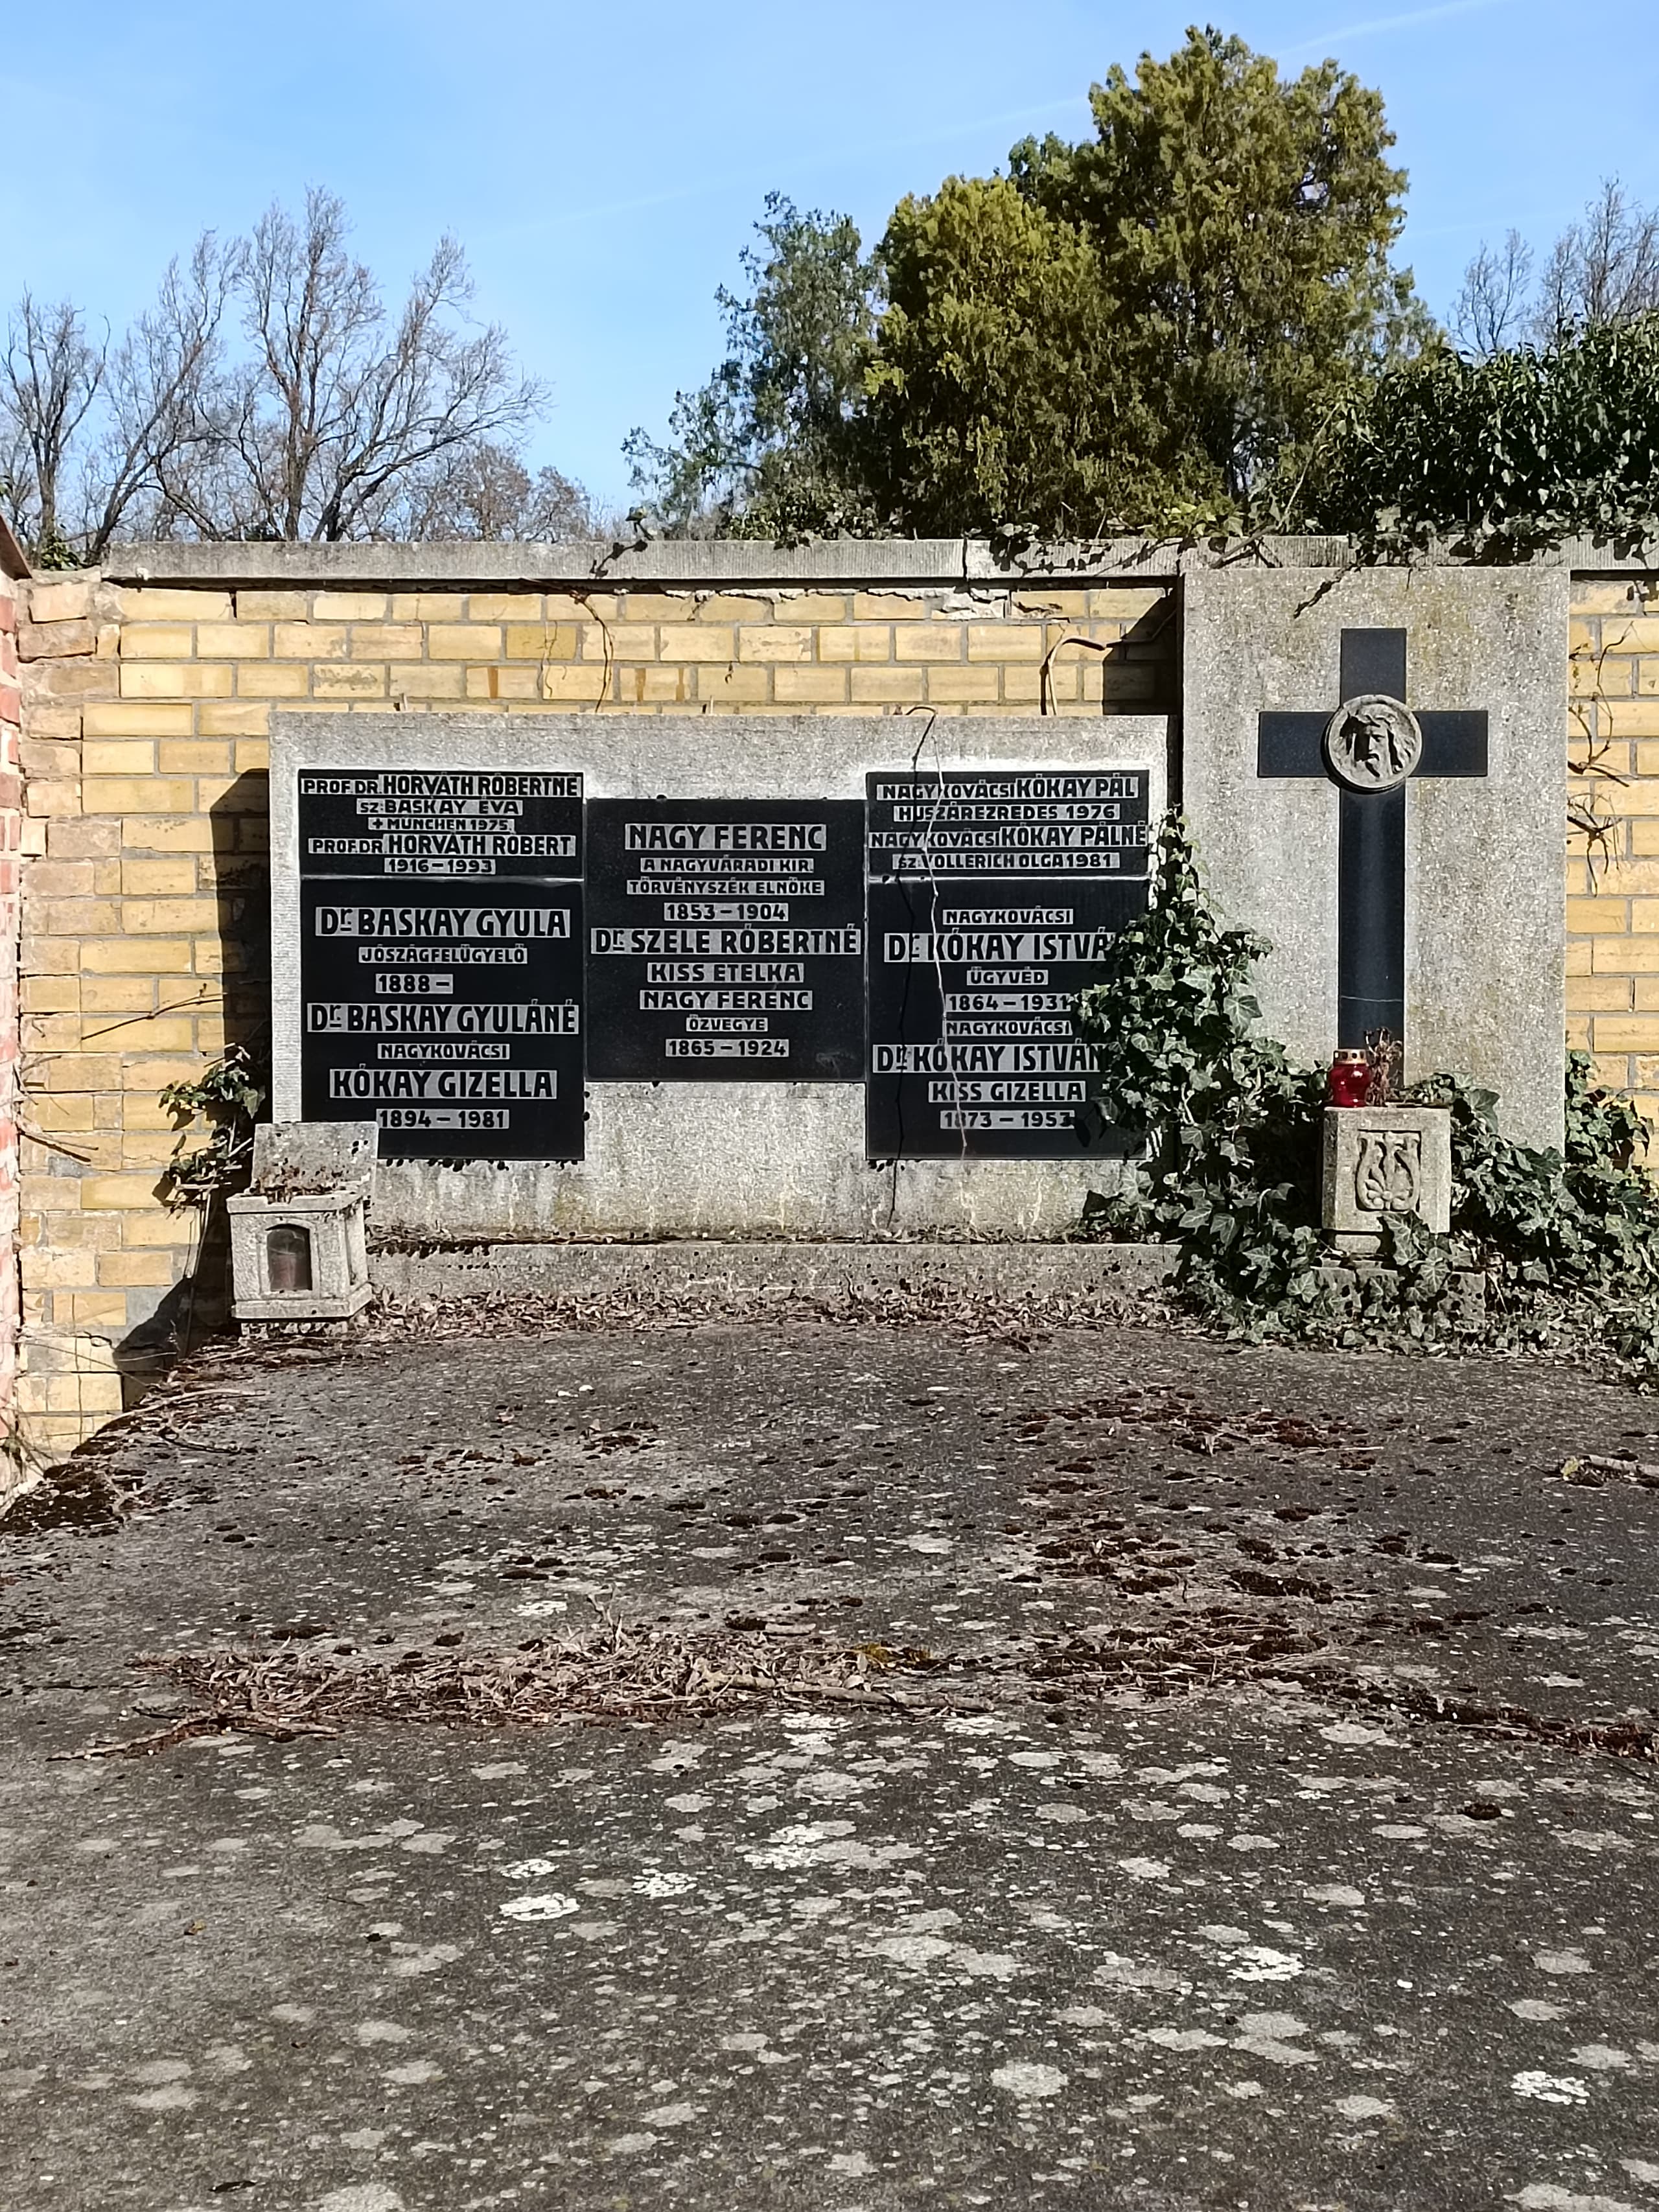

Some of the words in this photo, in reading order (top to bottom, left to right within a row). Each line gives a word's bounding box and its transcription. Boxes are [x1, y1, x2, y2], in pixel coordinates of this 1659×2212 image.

[384, 772, 473, 795] HORVÁTH
[478, 773, 577, 796] RÓBERTNÉ
[1096, 773, 1135, 797] PÁL
[385, 798, 467, 814] BASKAY
[479, 796, 519, 815] ÉVA
[899, 801, 1058, 821] HUSZÁREZREDES
[1066, 805, 1115, 819] 1976
[388, 815, 466, 830] MÜNCHEN
[389, 830, 485, 854] HORVÁTH
[629, 825, 706, 848] NAGY
[715, 826, 822, 850] FERENC
[1080, 821, 1146, 846] PÁLNÉ
[644, 859, 655, 871] A
[661, 854, 774, 871] NAGYVÁRADI
[922, 854, 1015, 868] VOLLERICH
[1019, 854, 1063, 868] OLGA
[1067, 854, 1111, 867] 1981
[629, 876, 750, 894] TÖRVÉNYSZÉK
[756, 876, 822, 894] ELNÖKE
[358, 909, 472, 937] BASKAY
[476, 909, 566, 937] GYULA
[946, 905, 1070, 924] NAGYKOVÁCSI
[631, 930, 710, 953] SZELE
[721, 924, 857, 953] RÓBERTNÉ
[1034, 927, 1117, 960] ISTVÁ
[651, 964, 705, 981] KISS
[713, 964, 800, 981] ETELKA
[971, 966, 1045, 984] ÜGYVÉD
[644, 992, 710, 1009] NAGY
[717, 992, 809, 1009] FERENC
[348, 1005, 455, 1032] BASKAY
[457, 999, 575, 1032] GYULÁNÉ
[688, 1014, 766, 1030] ÖZVEGYE
[946, 1016, 1070, 1034] NAGYKOVÁCSI
[381, 1040, 506, 1058] NAGYKOVÁCSI
[438, 1071, 553, 1098] GIZELLA
[932, 1082, 982, 1101] KISS
[990, 1082, 1083, 1100] GIZELLA
